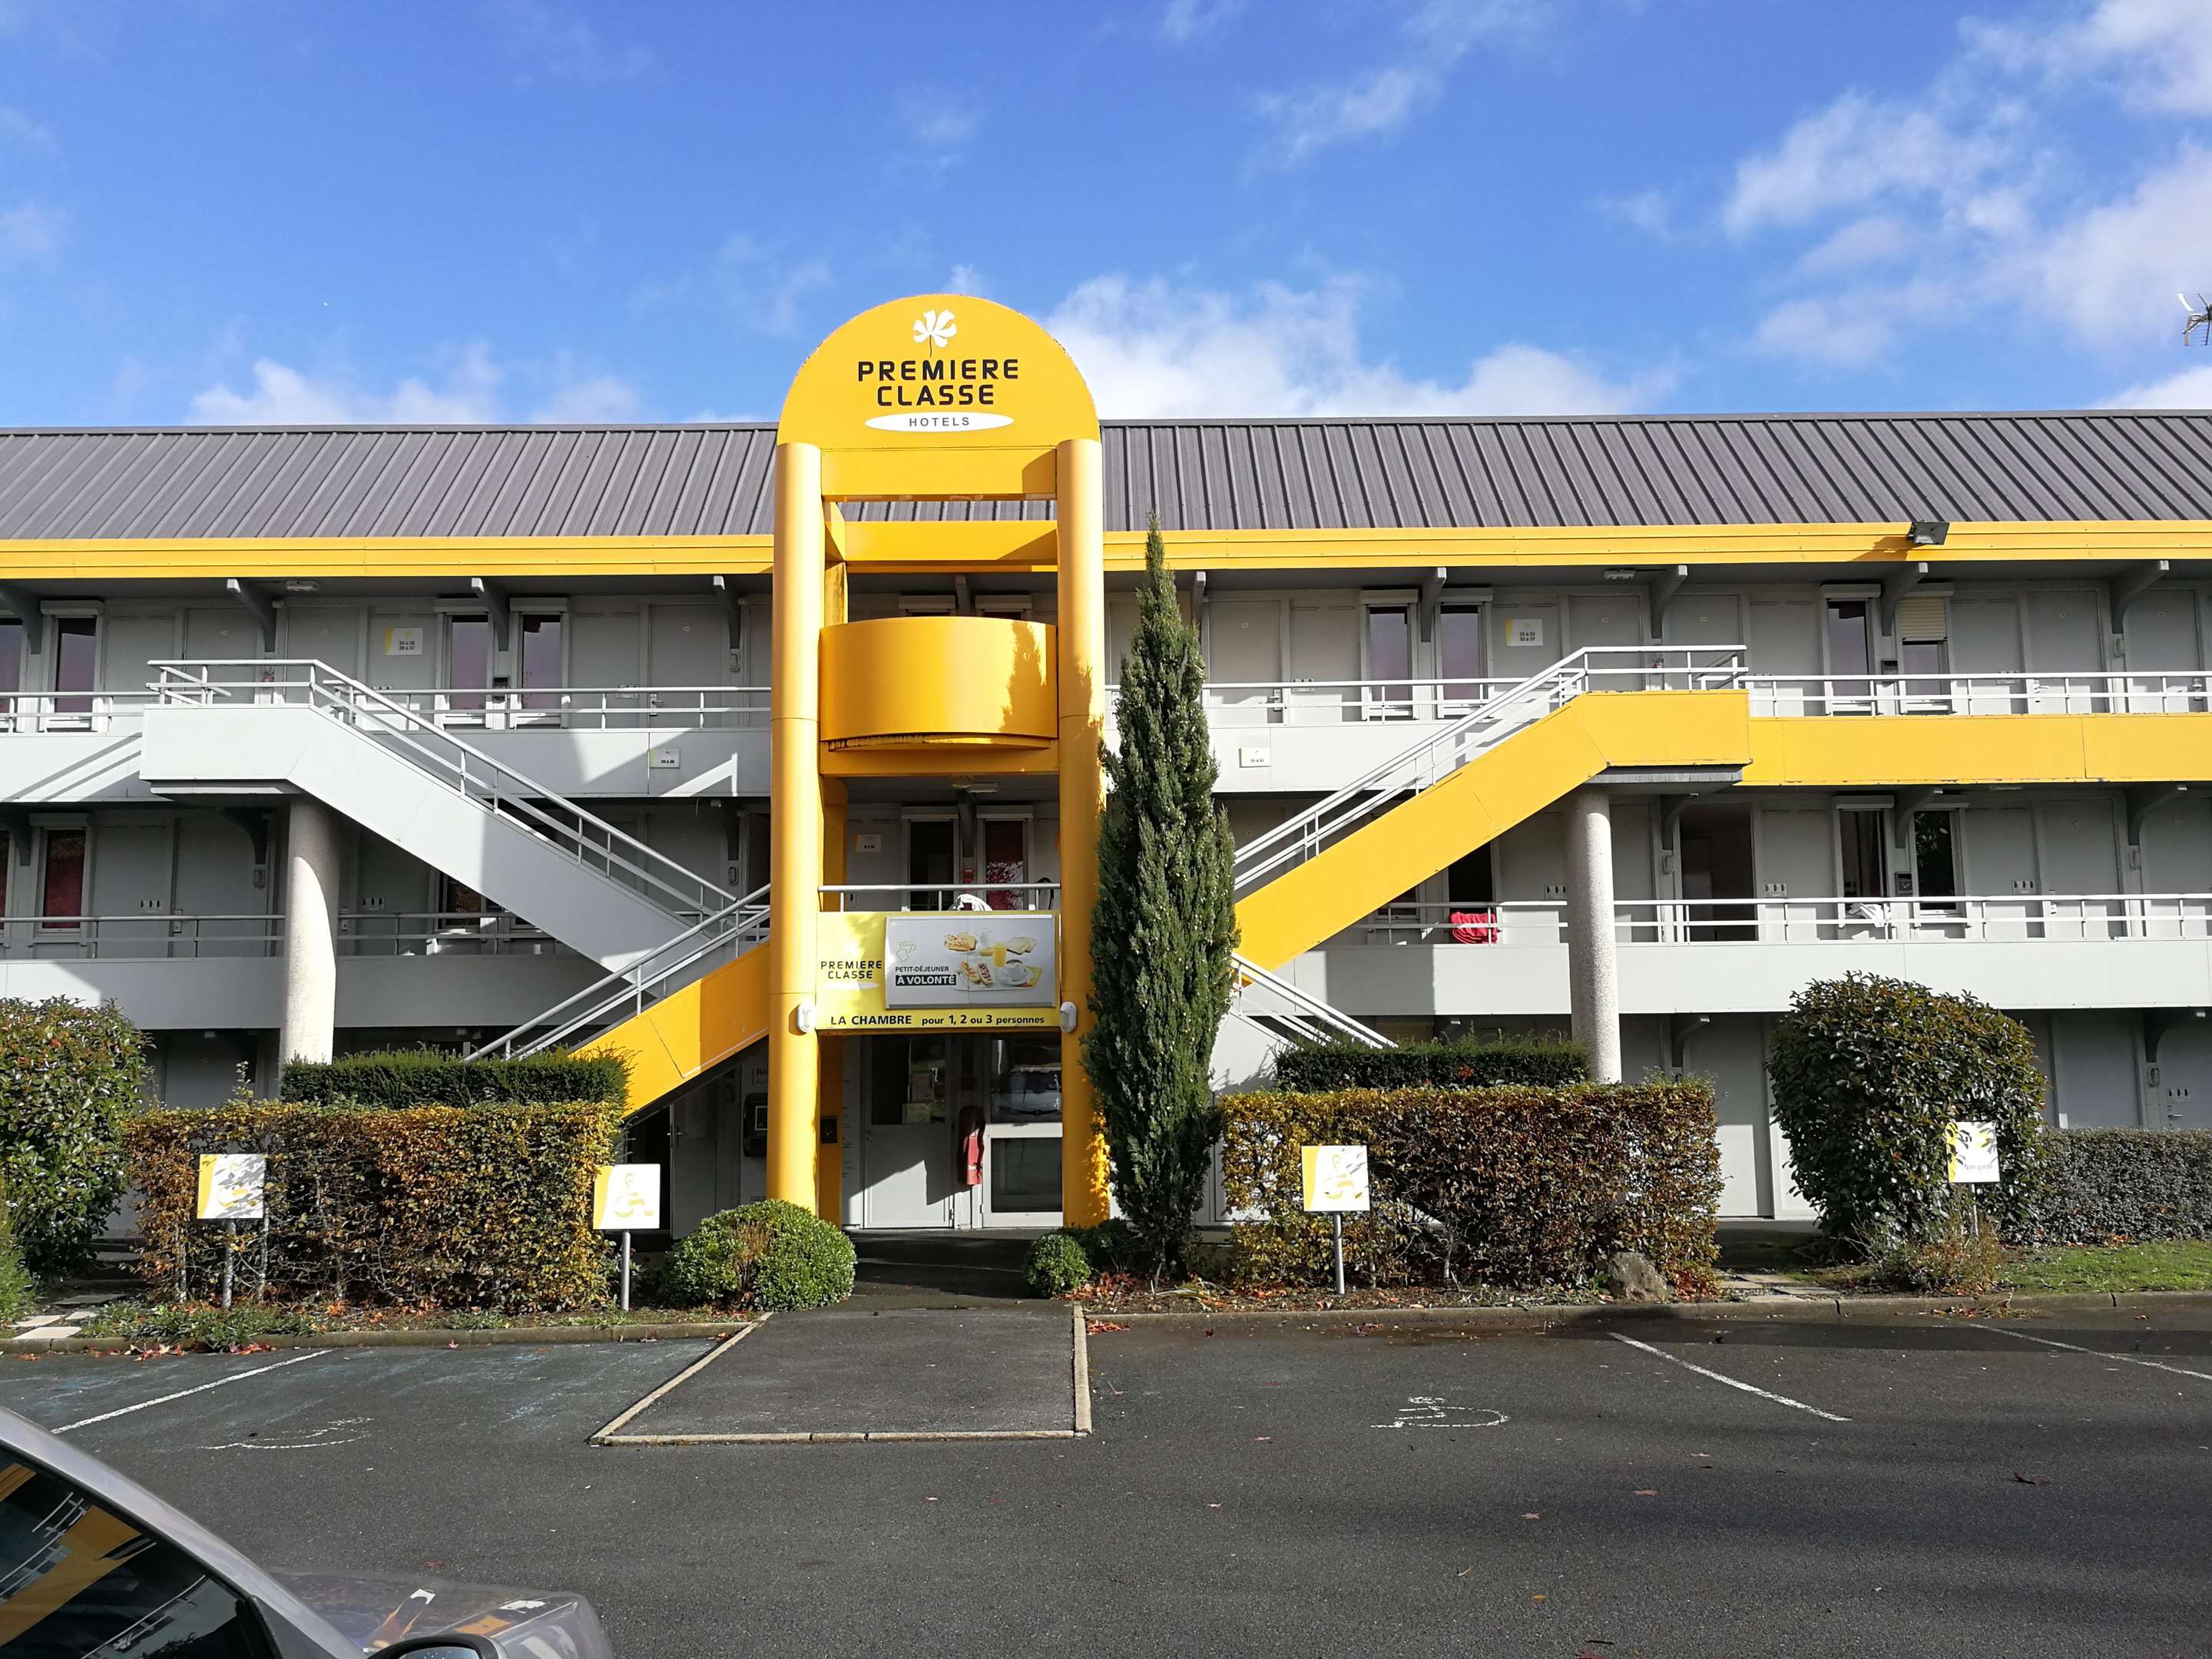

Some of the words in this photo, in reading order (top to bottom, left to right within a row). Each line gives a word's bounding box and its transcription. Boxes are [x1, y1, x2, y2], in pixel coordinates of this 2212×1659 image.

[858, 359, 1018, 382] PREMIERE
[877, 384, 995, 406] CLASSE
[909, 416, 970, 427] HOTELS
[821, 960, 882, 969] PREMIERE
[828, 970, 873, 979] CLASSE
[906, 975, 955, 985] VOLONTÉ
[830, 1016, 846, 1025] LA
[852, 1015, 912, 1025] CHAMBRE
[922, 1018, 944, 1026] pour
[948, 1015, 957, 1026] 1,
[960, 1015, 967, 1024] 2
[986, 1015, 993, 1024] 3
[996, 1016, 1045, 1025] personnes
